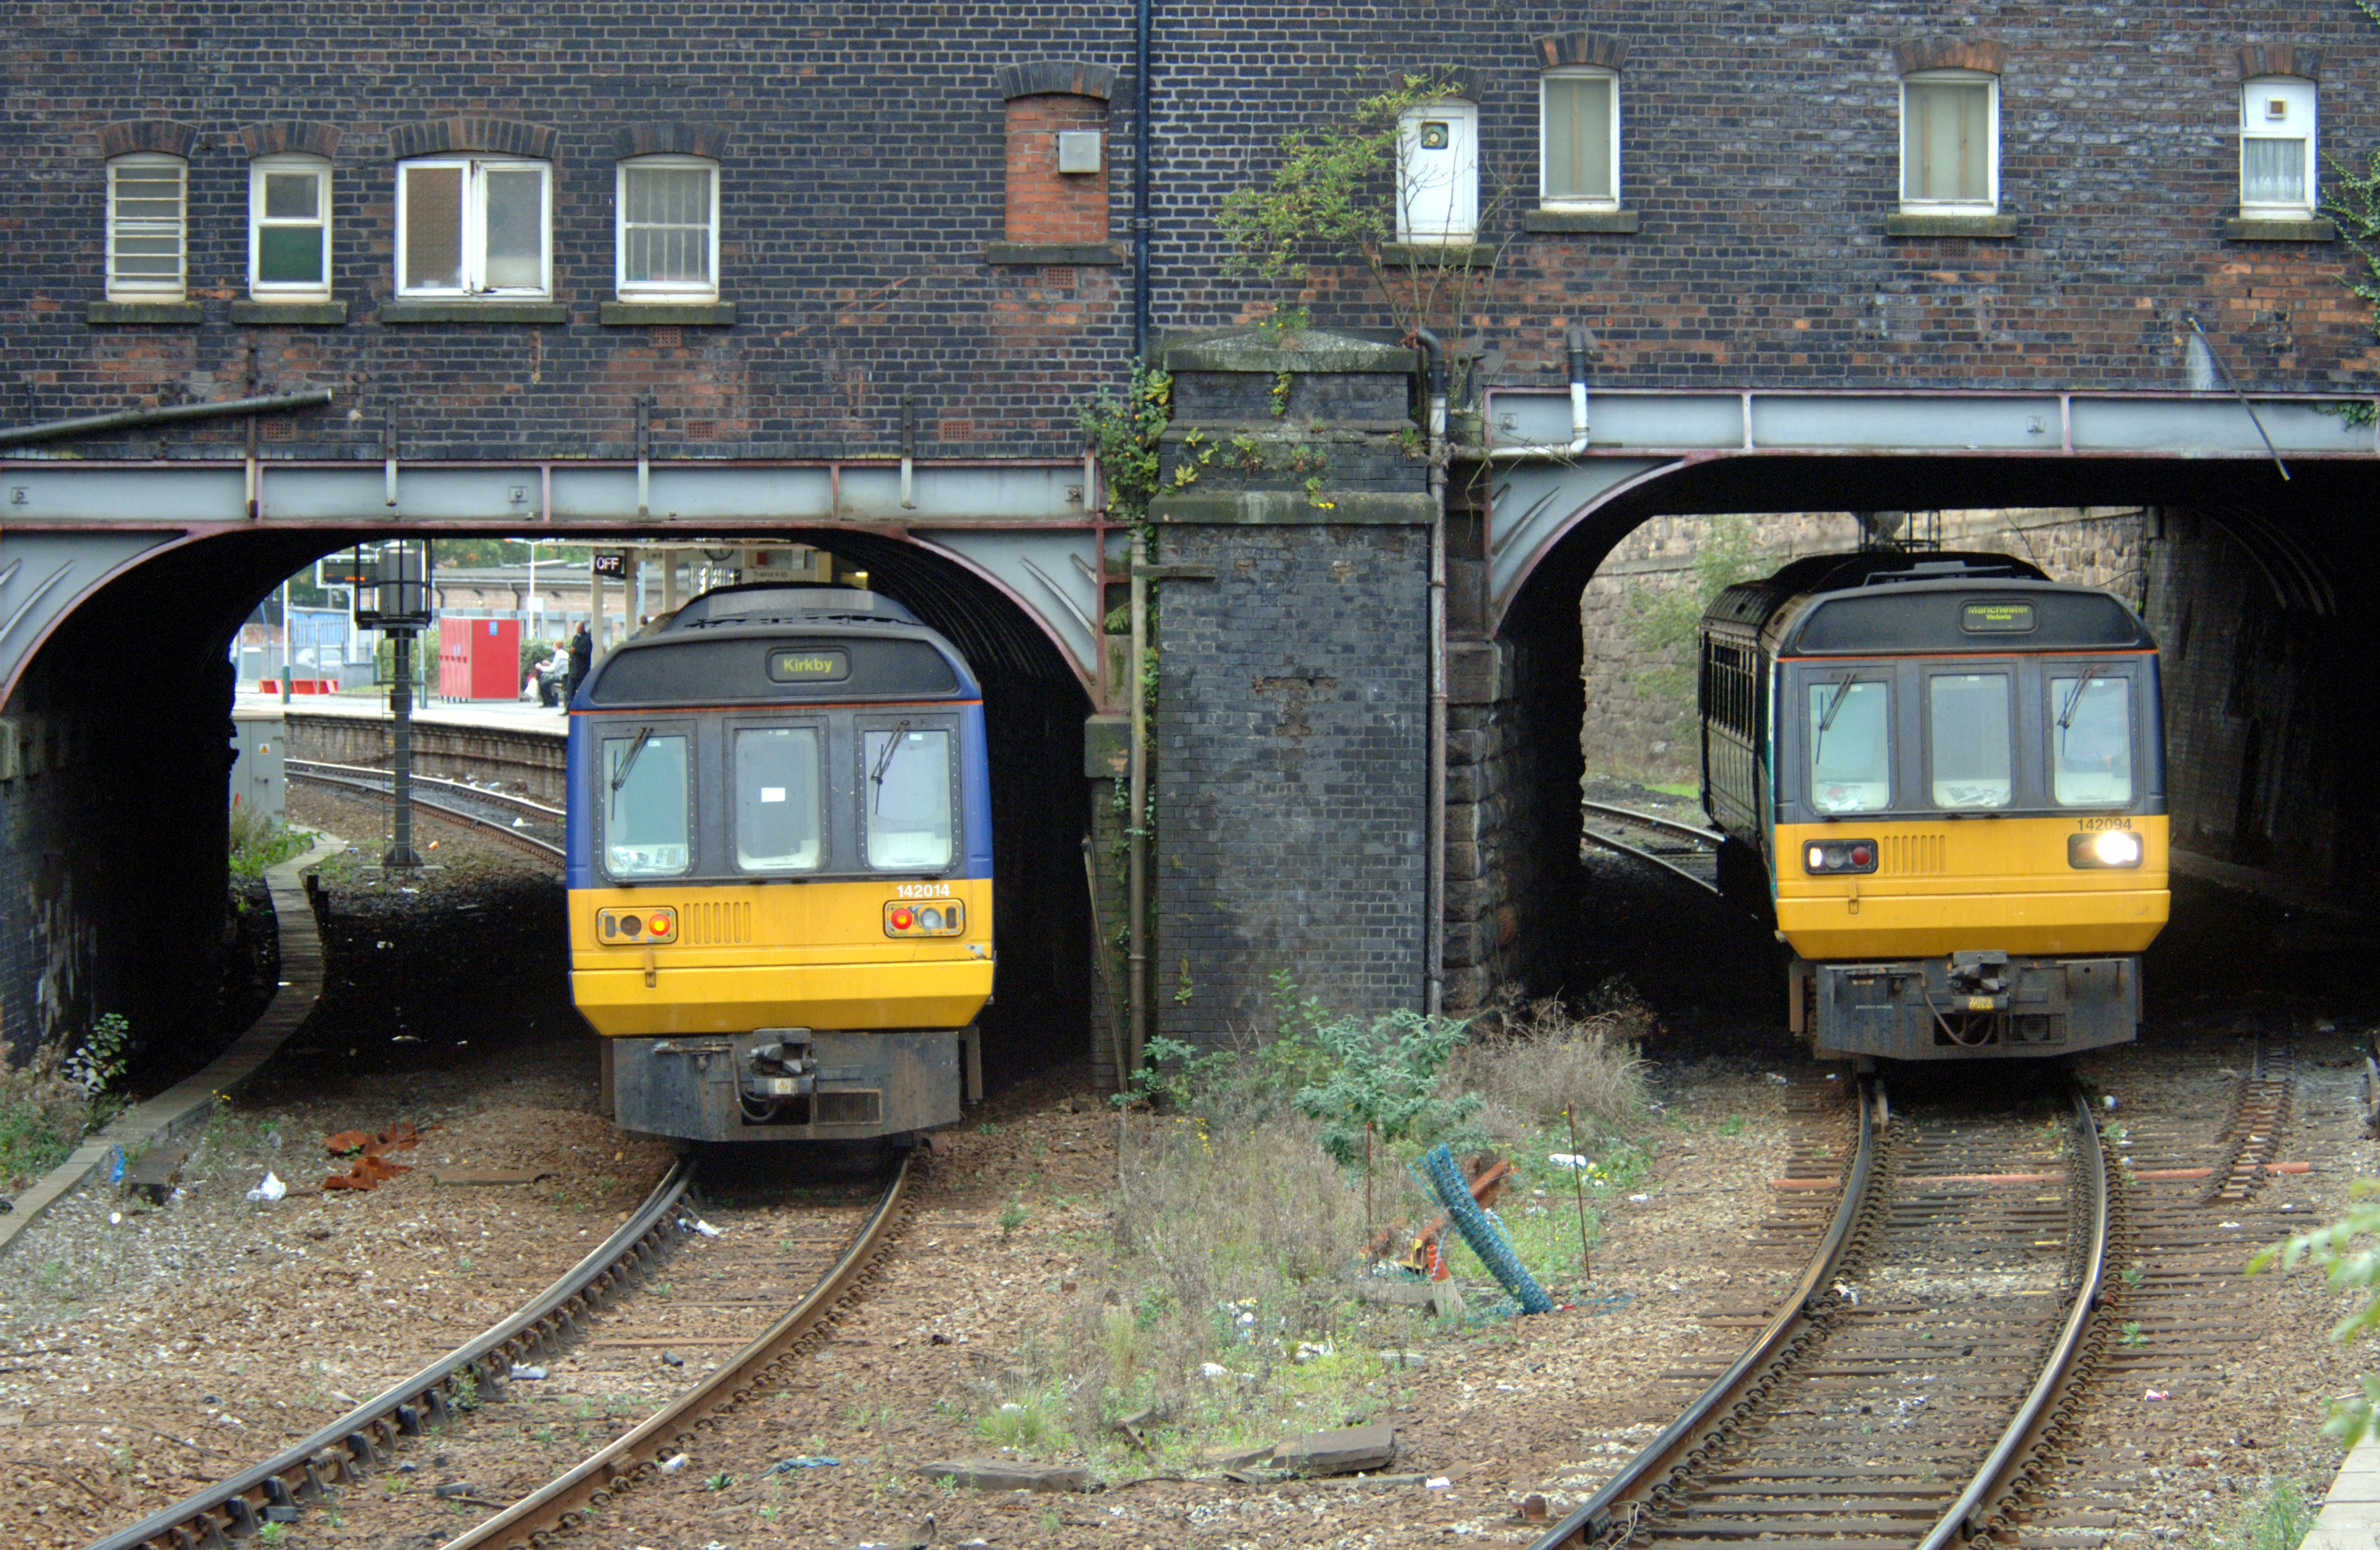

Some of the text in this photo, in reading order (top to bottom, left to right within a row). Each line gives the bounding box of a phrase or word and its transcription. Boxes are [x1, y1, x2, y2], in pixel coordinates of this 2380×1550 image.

[596, 557, 619, 570] OFF
[784, 659, 832, 673] Kirkby
[2077, 818, 2132, 831] 142094
[897, 884, 950, 898] 142014
